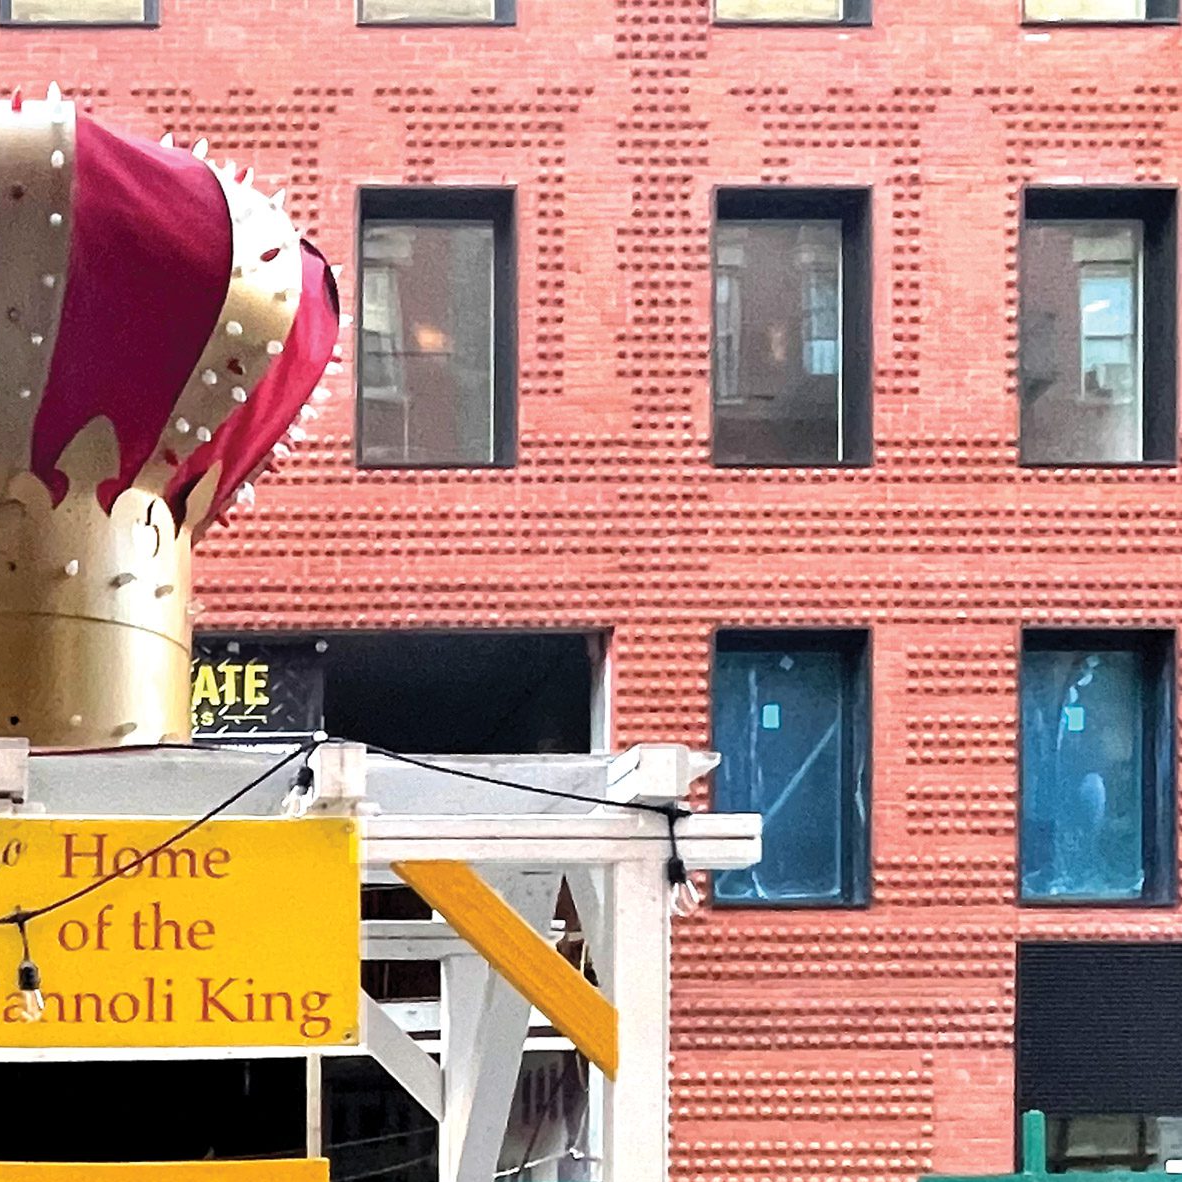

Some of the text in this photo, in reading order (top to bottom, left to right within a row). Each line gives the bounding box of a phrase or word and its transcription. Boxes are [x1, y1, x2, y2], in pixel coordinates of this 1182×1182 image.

[59, 832, 232, 880] Home
[58, 901, 216, 952] of the
[196, 977, 332, 1039] King
